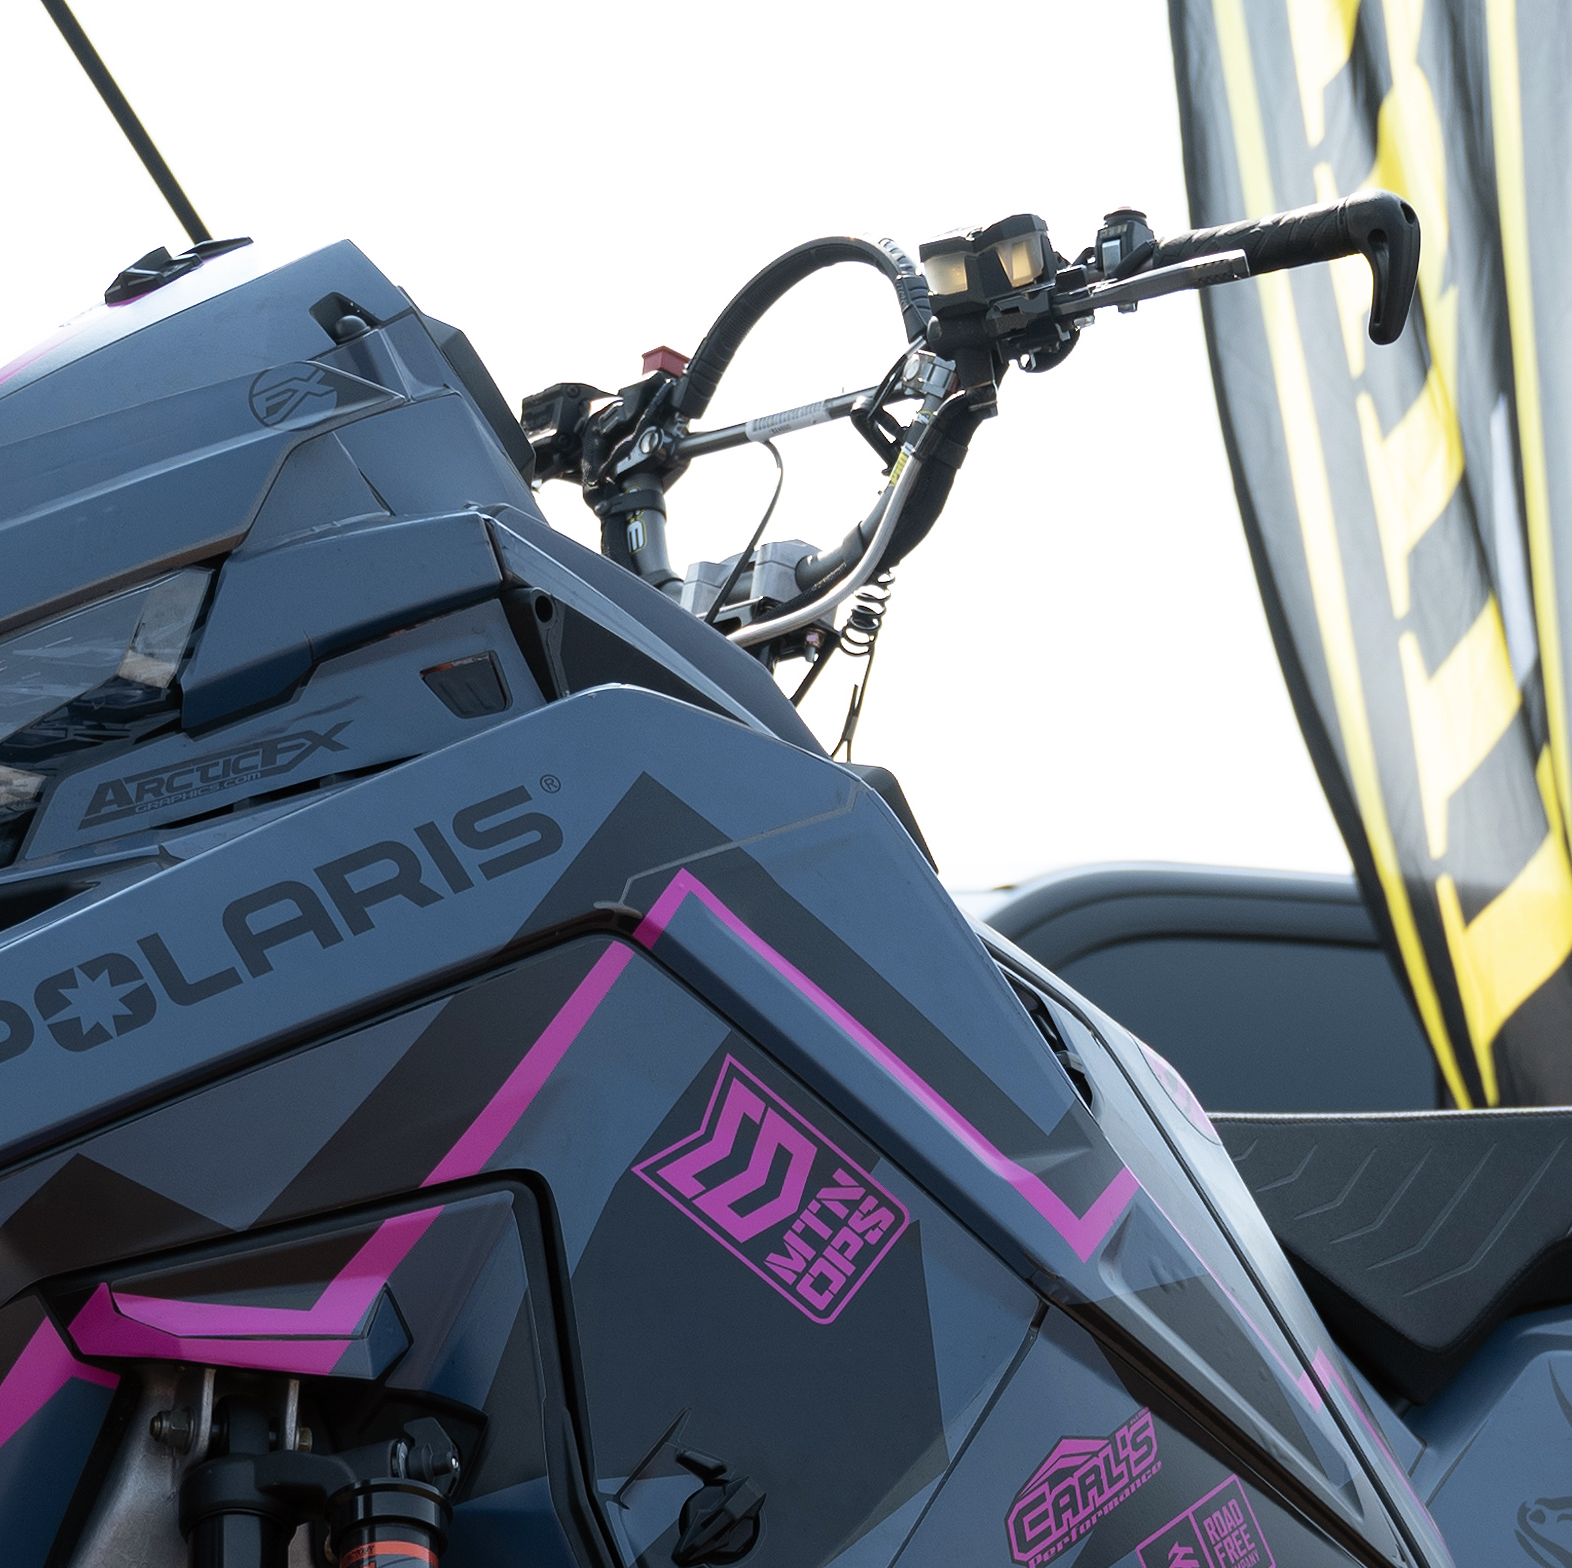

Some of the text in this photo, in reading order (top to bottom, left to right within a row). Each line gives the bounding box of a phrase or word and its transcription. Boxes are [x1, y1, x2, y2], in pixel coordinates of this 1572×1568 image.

[764, 1167, 867, 1286] MTN
[795, 1195, 896, 1311] OPS
[1203, 1498, 1244, 1545] ROAD
